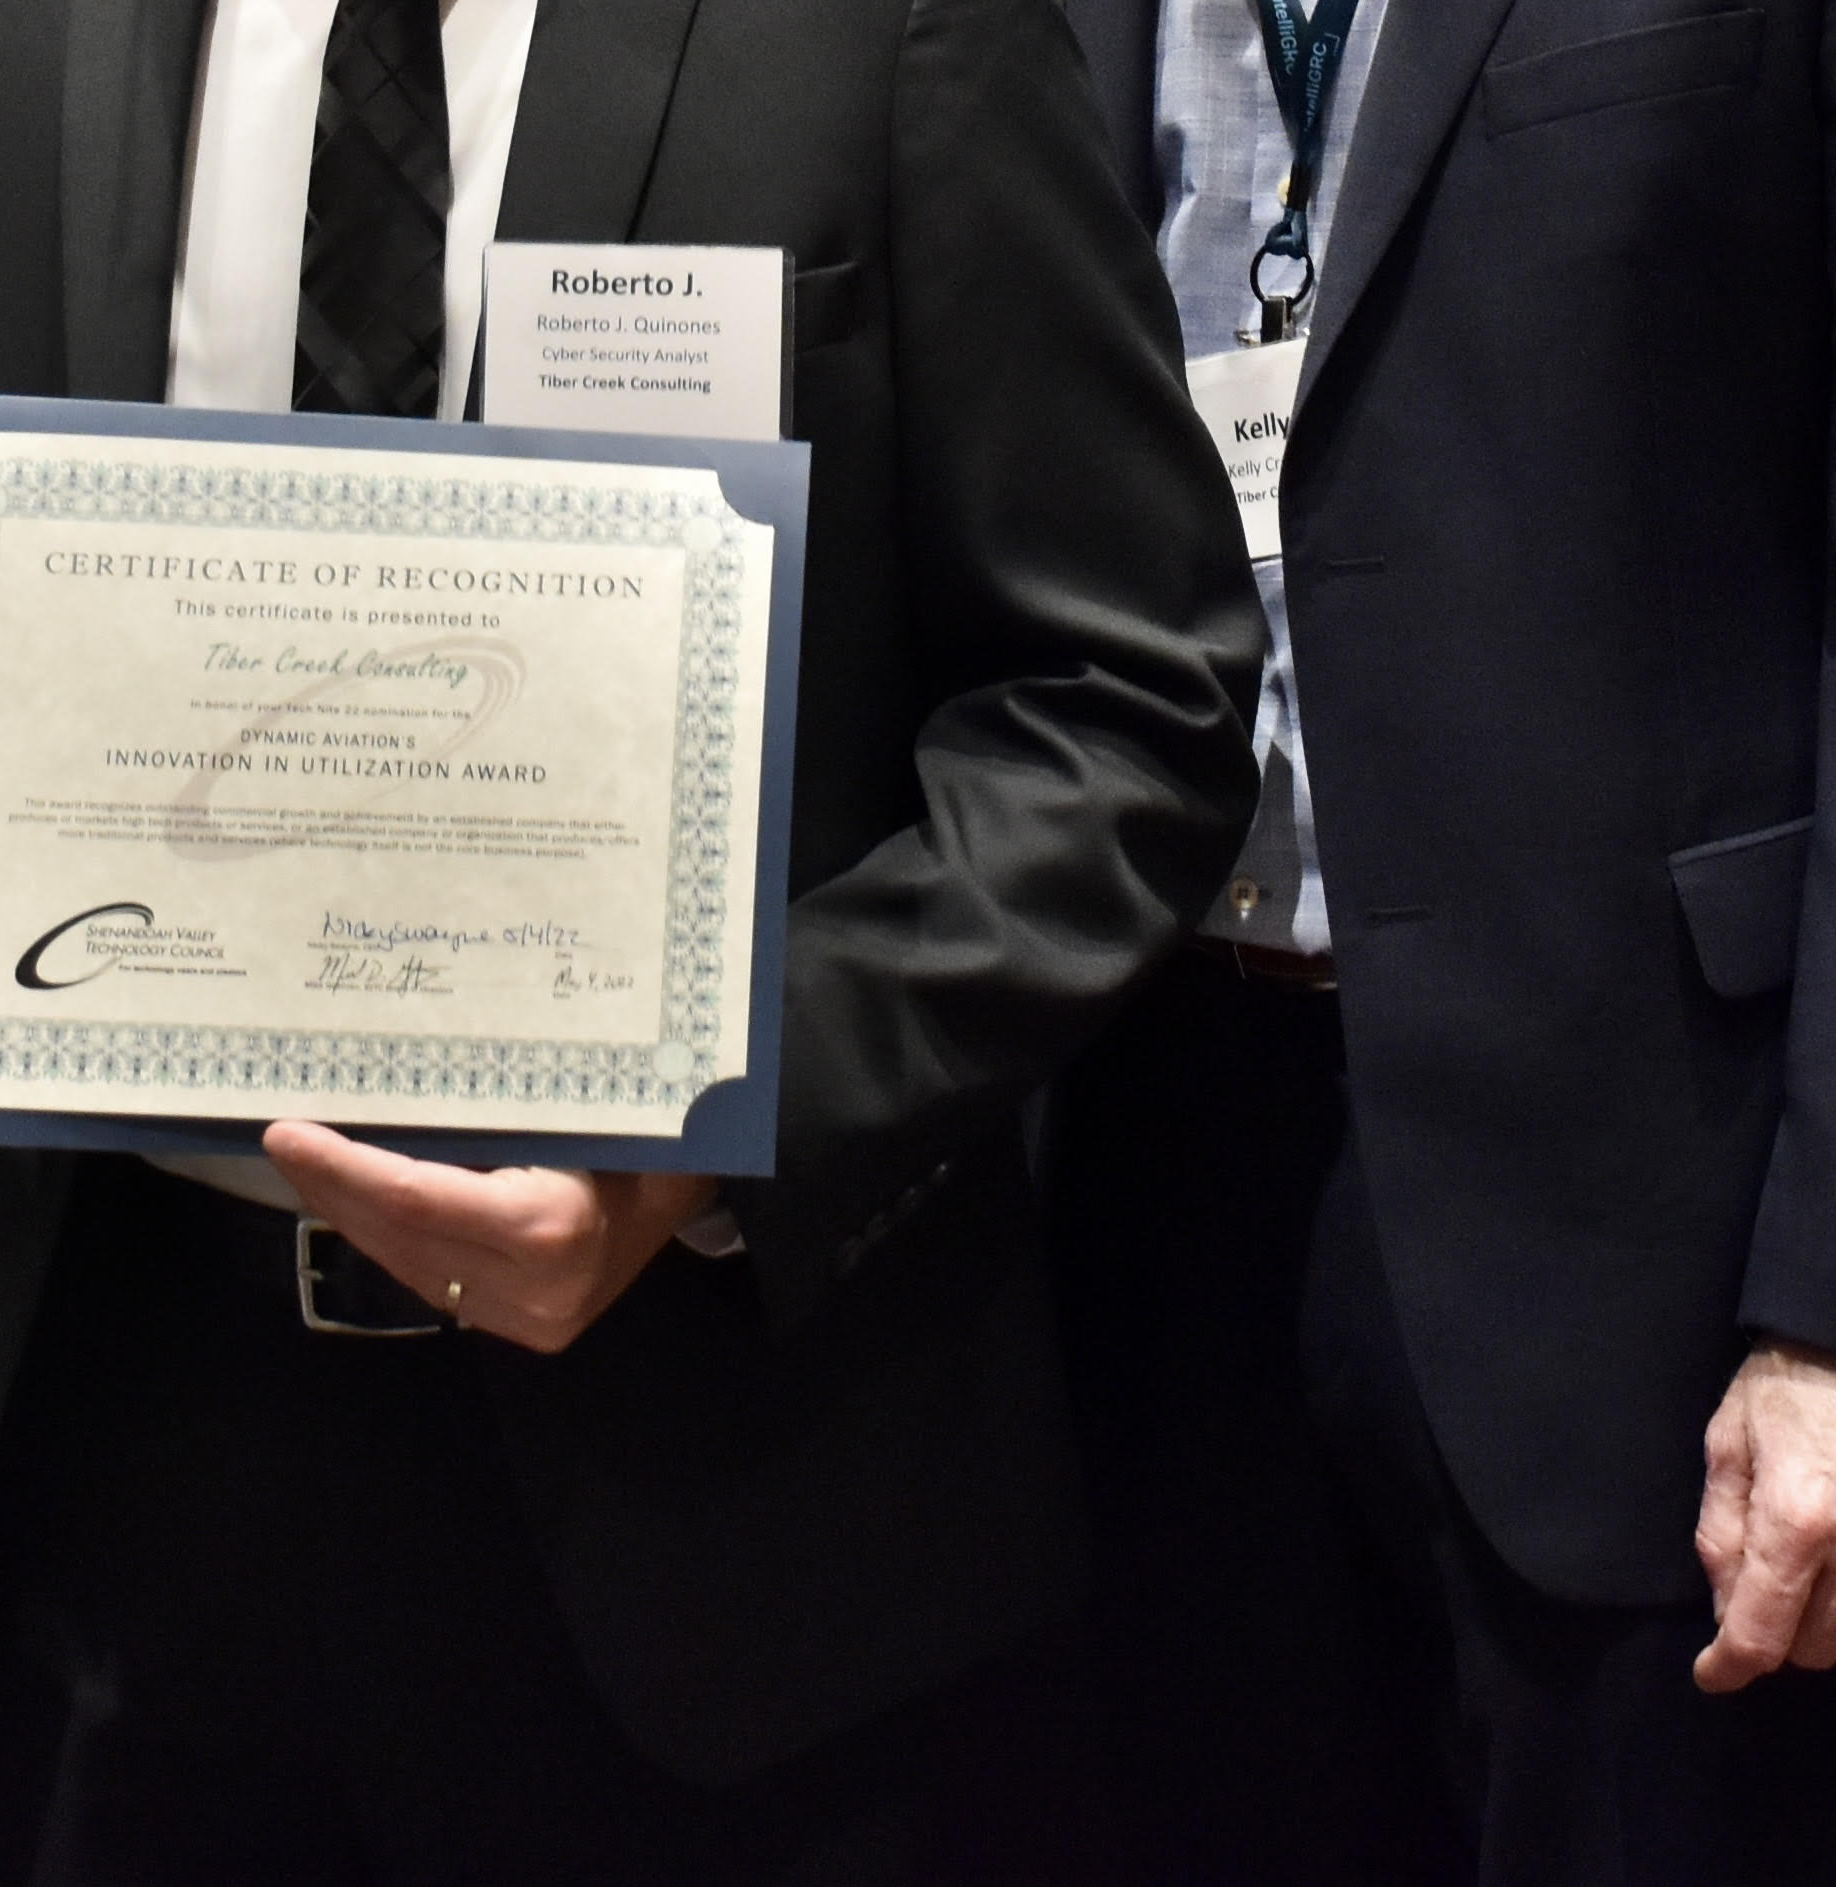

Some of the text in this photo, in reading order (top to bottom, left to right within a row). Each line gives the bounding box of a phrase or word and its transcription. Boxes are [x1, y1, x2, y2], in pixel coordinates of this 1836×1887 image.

[551, 269, 703, 297] Roberto J.
[537, 314, 721, 336] Roberto J. Quinones
[542, 346, 709, 365] Cyber Security Analyst
[539, 374, 711, 394] Tiber Creek Consulting
[1234, 412, 1290, 442] Kelly
[1228, 462, 1261, 480] Kelly
[1236, 488, 1267, 503] Tiber
[44, 552, 644, 598] CERTIFICATE OF RECOGNITION
[174, 599, 500, 628] This certificate is presented to
[204, 642, 468, 689] Tiber Creek Consulting
[240, 728, 416, 750] DYNAMIC AVIATION'S
[106, 749, 546, 785] INNOVATION IN UTILIZATION AWARD
[86, 924, 217, 943] SHENANDOAH VALLEY
[85, 941, 225, 960] TECHNOLOGY COUNCIL
